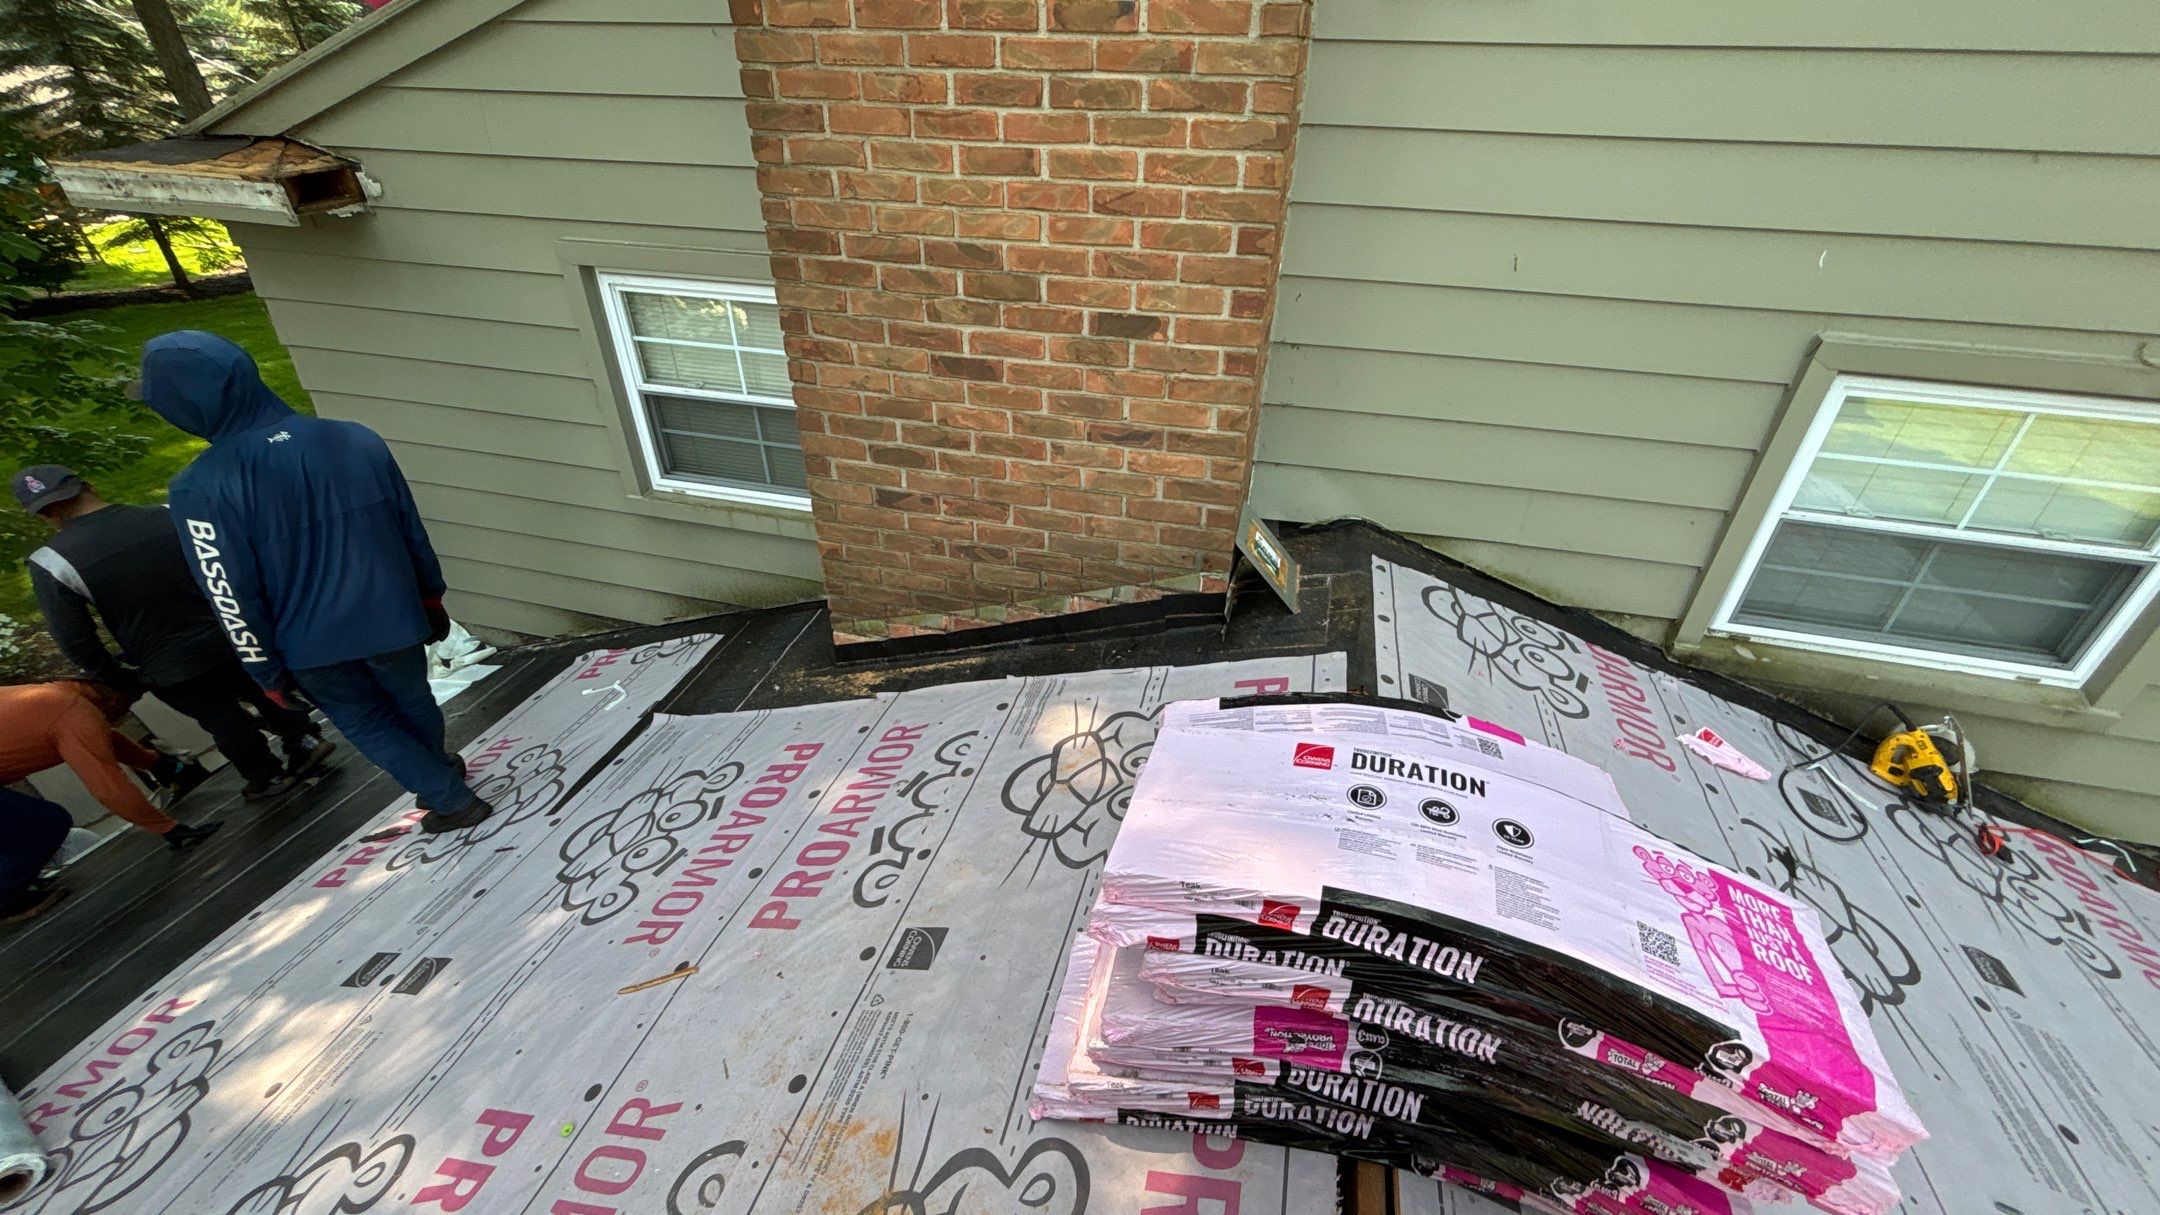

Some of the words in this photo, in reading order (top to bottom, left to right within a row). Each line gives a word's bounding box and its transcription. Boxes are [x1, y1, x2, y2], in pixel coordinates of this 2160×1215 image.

[186, 519, 268, 662] BASSDASH
[1296, 758, 1331, 768] CORNING
[1303, 754, 1331, 764] OWENS
[1351, 752, 1487, 798] DURATION
[1180, 881, 1200, 890] Teak
[1728, 885, 1782, 921] MORE
[1734, 903, 1797, 947] THAN
[1747, 926, 1787, 956] JUST
[893, 930, 919, 968] CORNING
[900, 936, 922, 968] OWENS
[1322, 915, 1484, 984] DURATION
[1753, 944, 1814, 986] ROOF
[1612, 1053, 1639, 1070] TOTAL
[1288, 1068, 1424, 1124] DURATION
